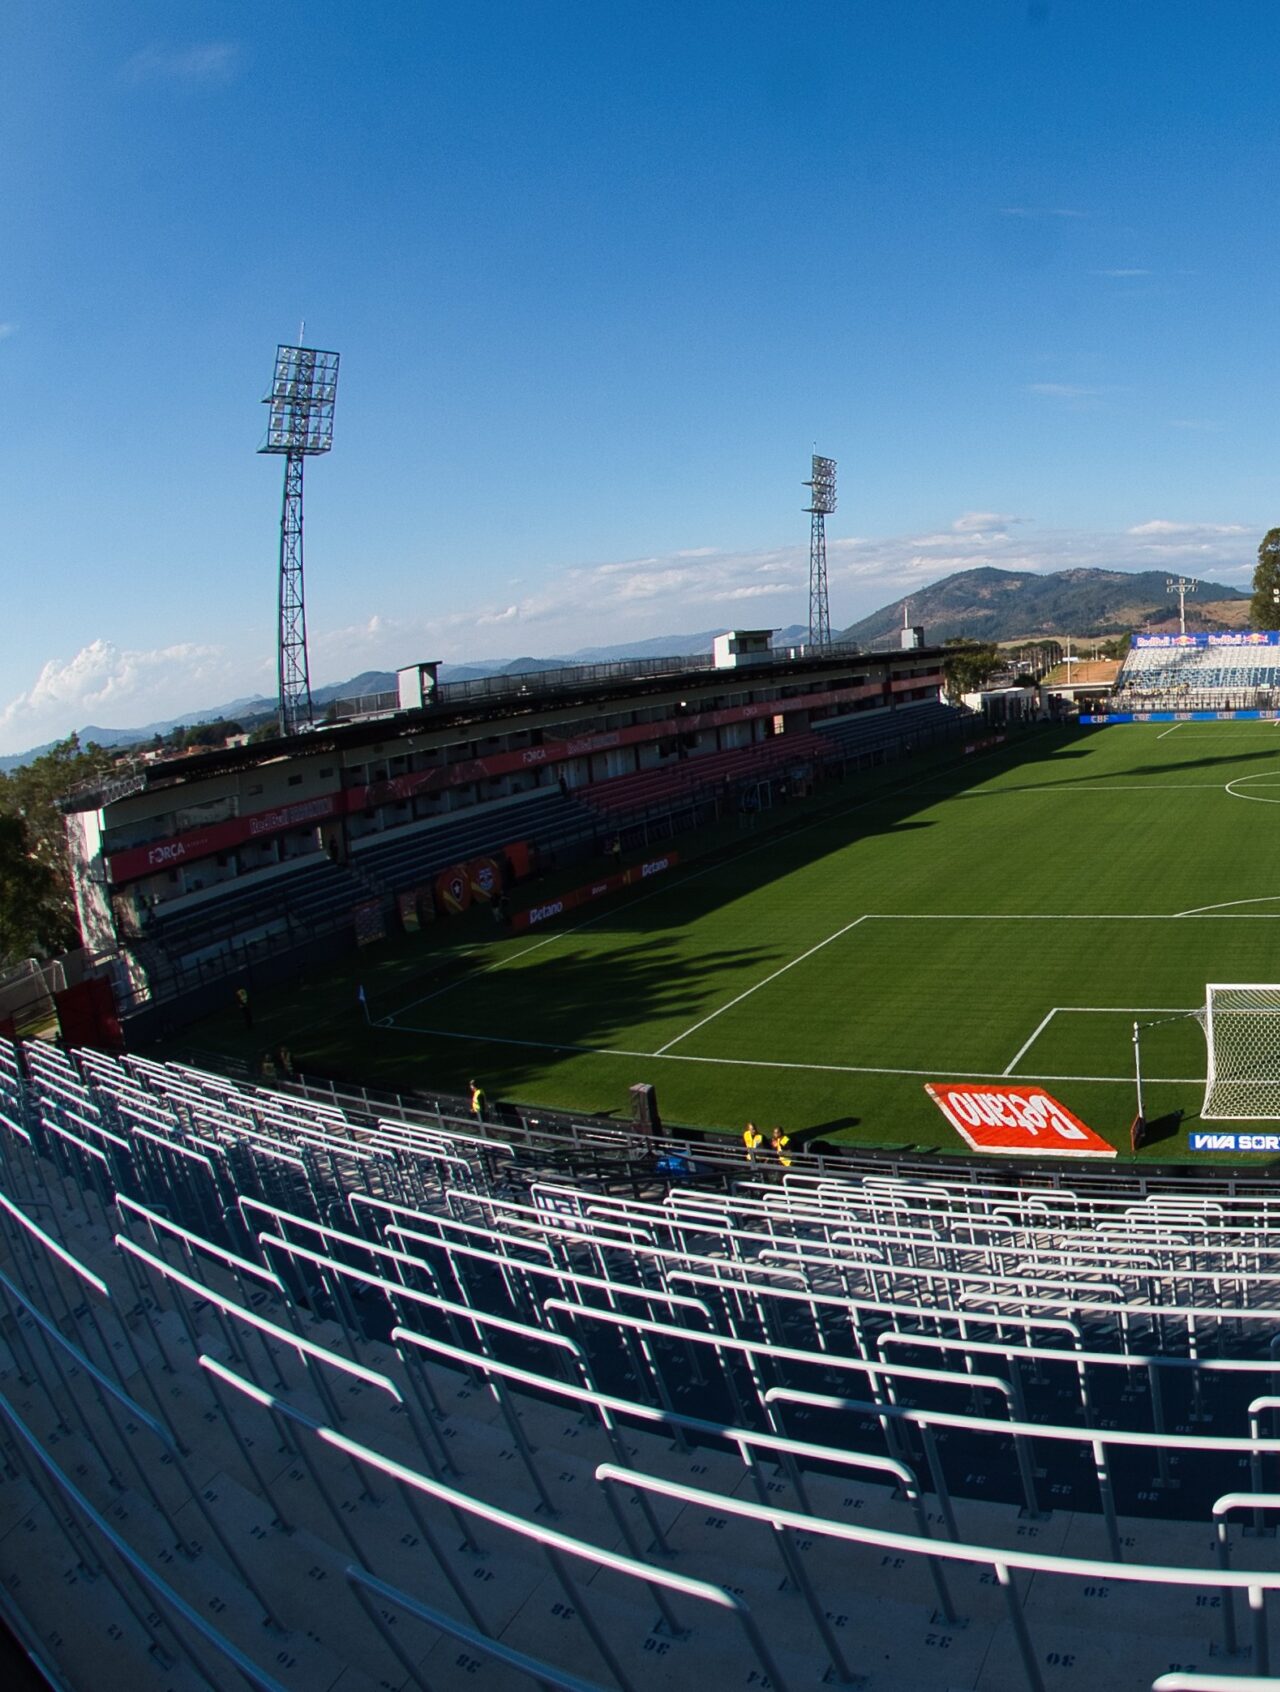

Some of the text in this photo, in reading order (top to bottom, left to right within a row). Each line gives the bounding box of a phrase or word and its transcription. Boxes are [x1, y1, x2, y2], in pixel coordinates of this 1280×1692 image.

[148, 842, 186, 865] FORÇA
[529, 901, 563, 925] Betano
[948, 1092, 1089, 1140] Betano
[1050, 1484, 1072, 1496] 32
[1136, 1490, 1160, 1502] 30
[844, 1498, 864, 1510] 36
[704, 1516, 728, 1531] 38
[1017, 1526, 1040, 1538] 32
[880, 1556, 906, 1570] 34
[1084, 1586, 1110, 1598] 30
[1195, 1595, 1222, 1608] 28
[550, 1602, 576, 1621] 38
[643, 1638, 670, 1657] 36
[924, 1634, 954, 1649] 32
[455, 1652, 482, 1675] 38
[1046, 1652, 1076, 1668] 30
